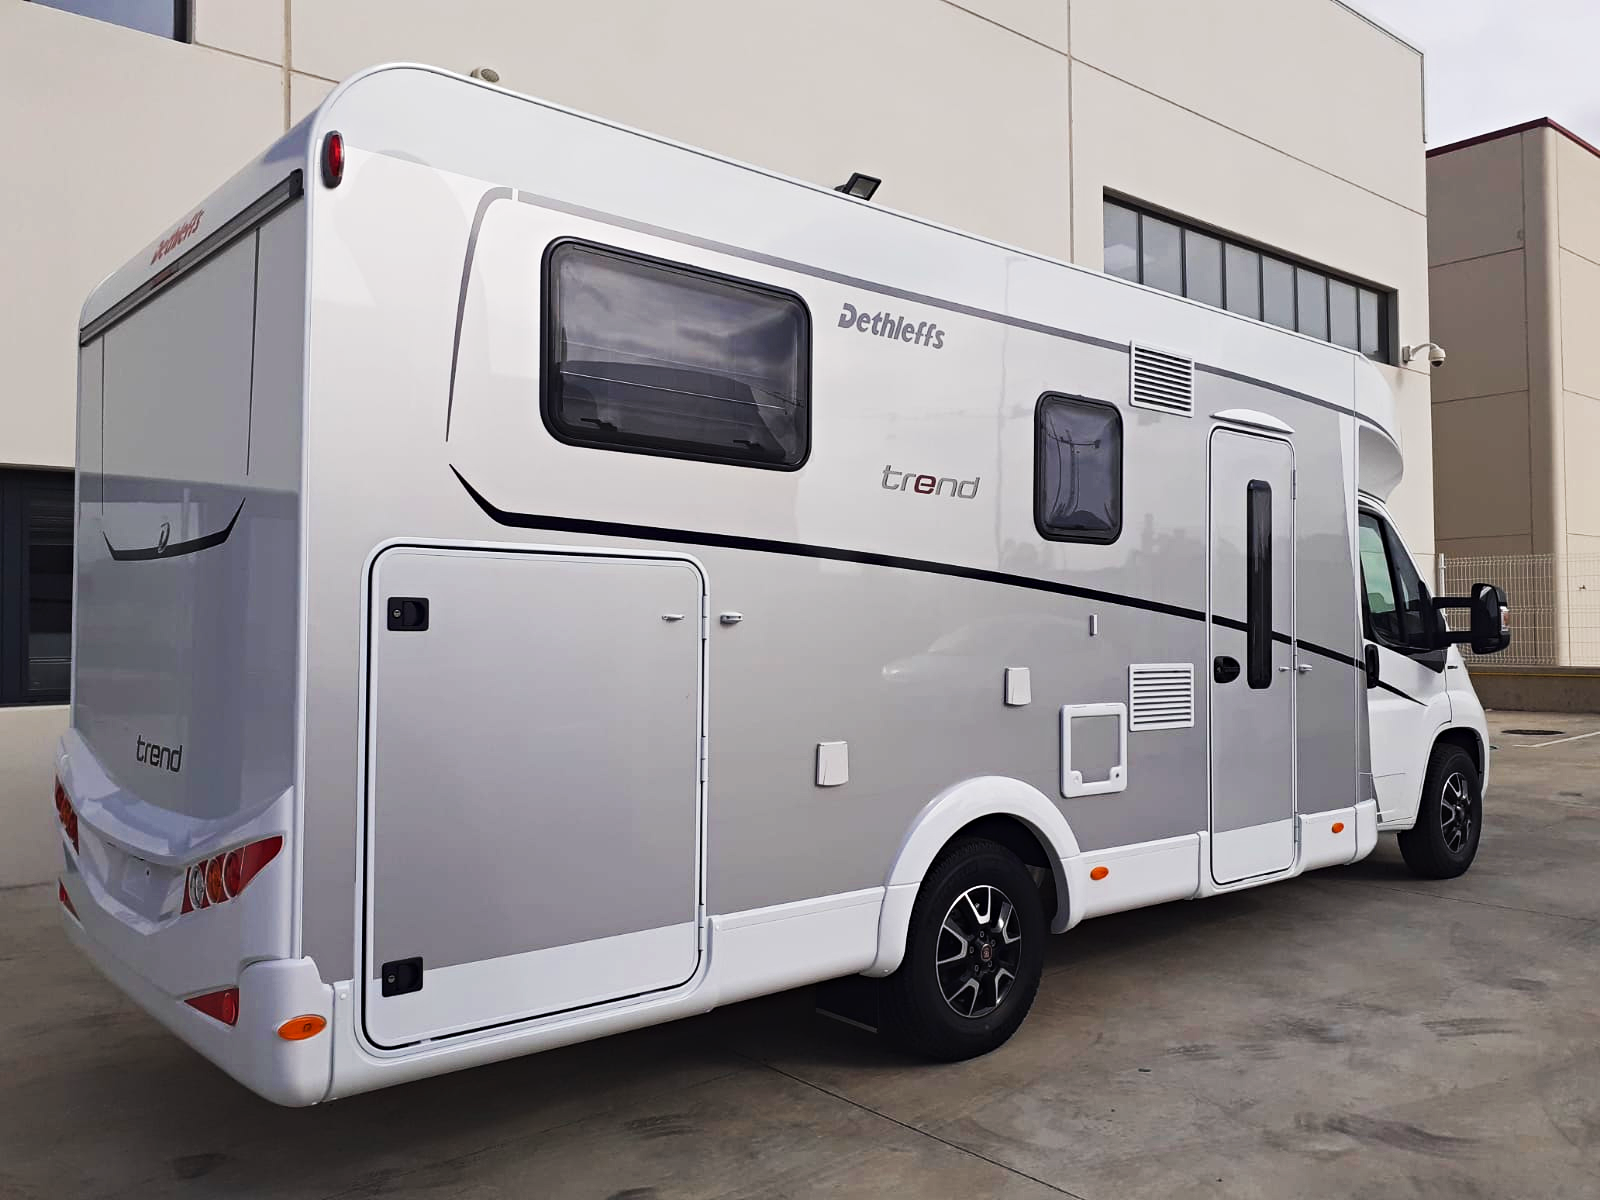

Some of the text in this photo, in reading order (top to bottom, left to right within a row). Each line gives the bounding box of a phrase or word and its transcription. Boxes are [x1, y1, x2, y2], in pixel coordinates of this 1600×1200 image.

[837, 302, 946, 350] Dethleffs
[881, 464, 981, 499] trend
[136, 734, 183, 773] trend
